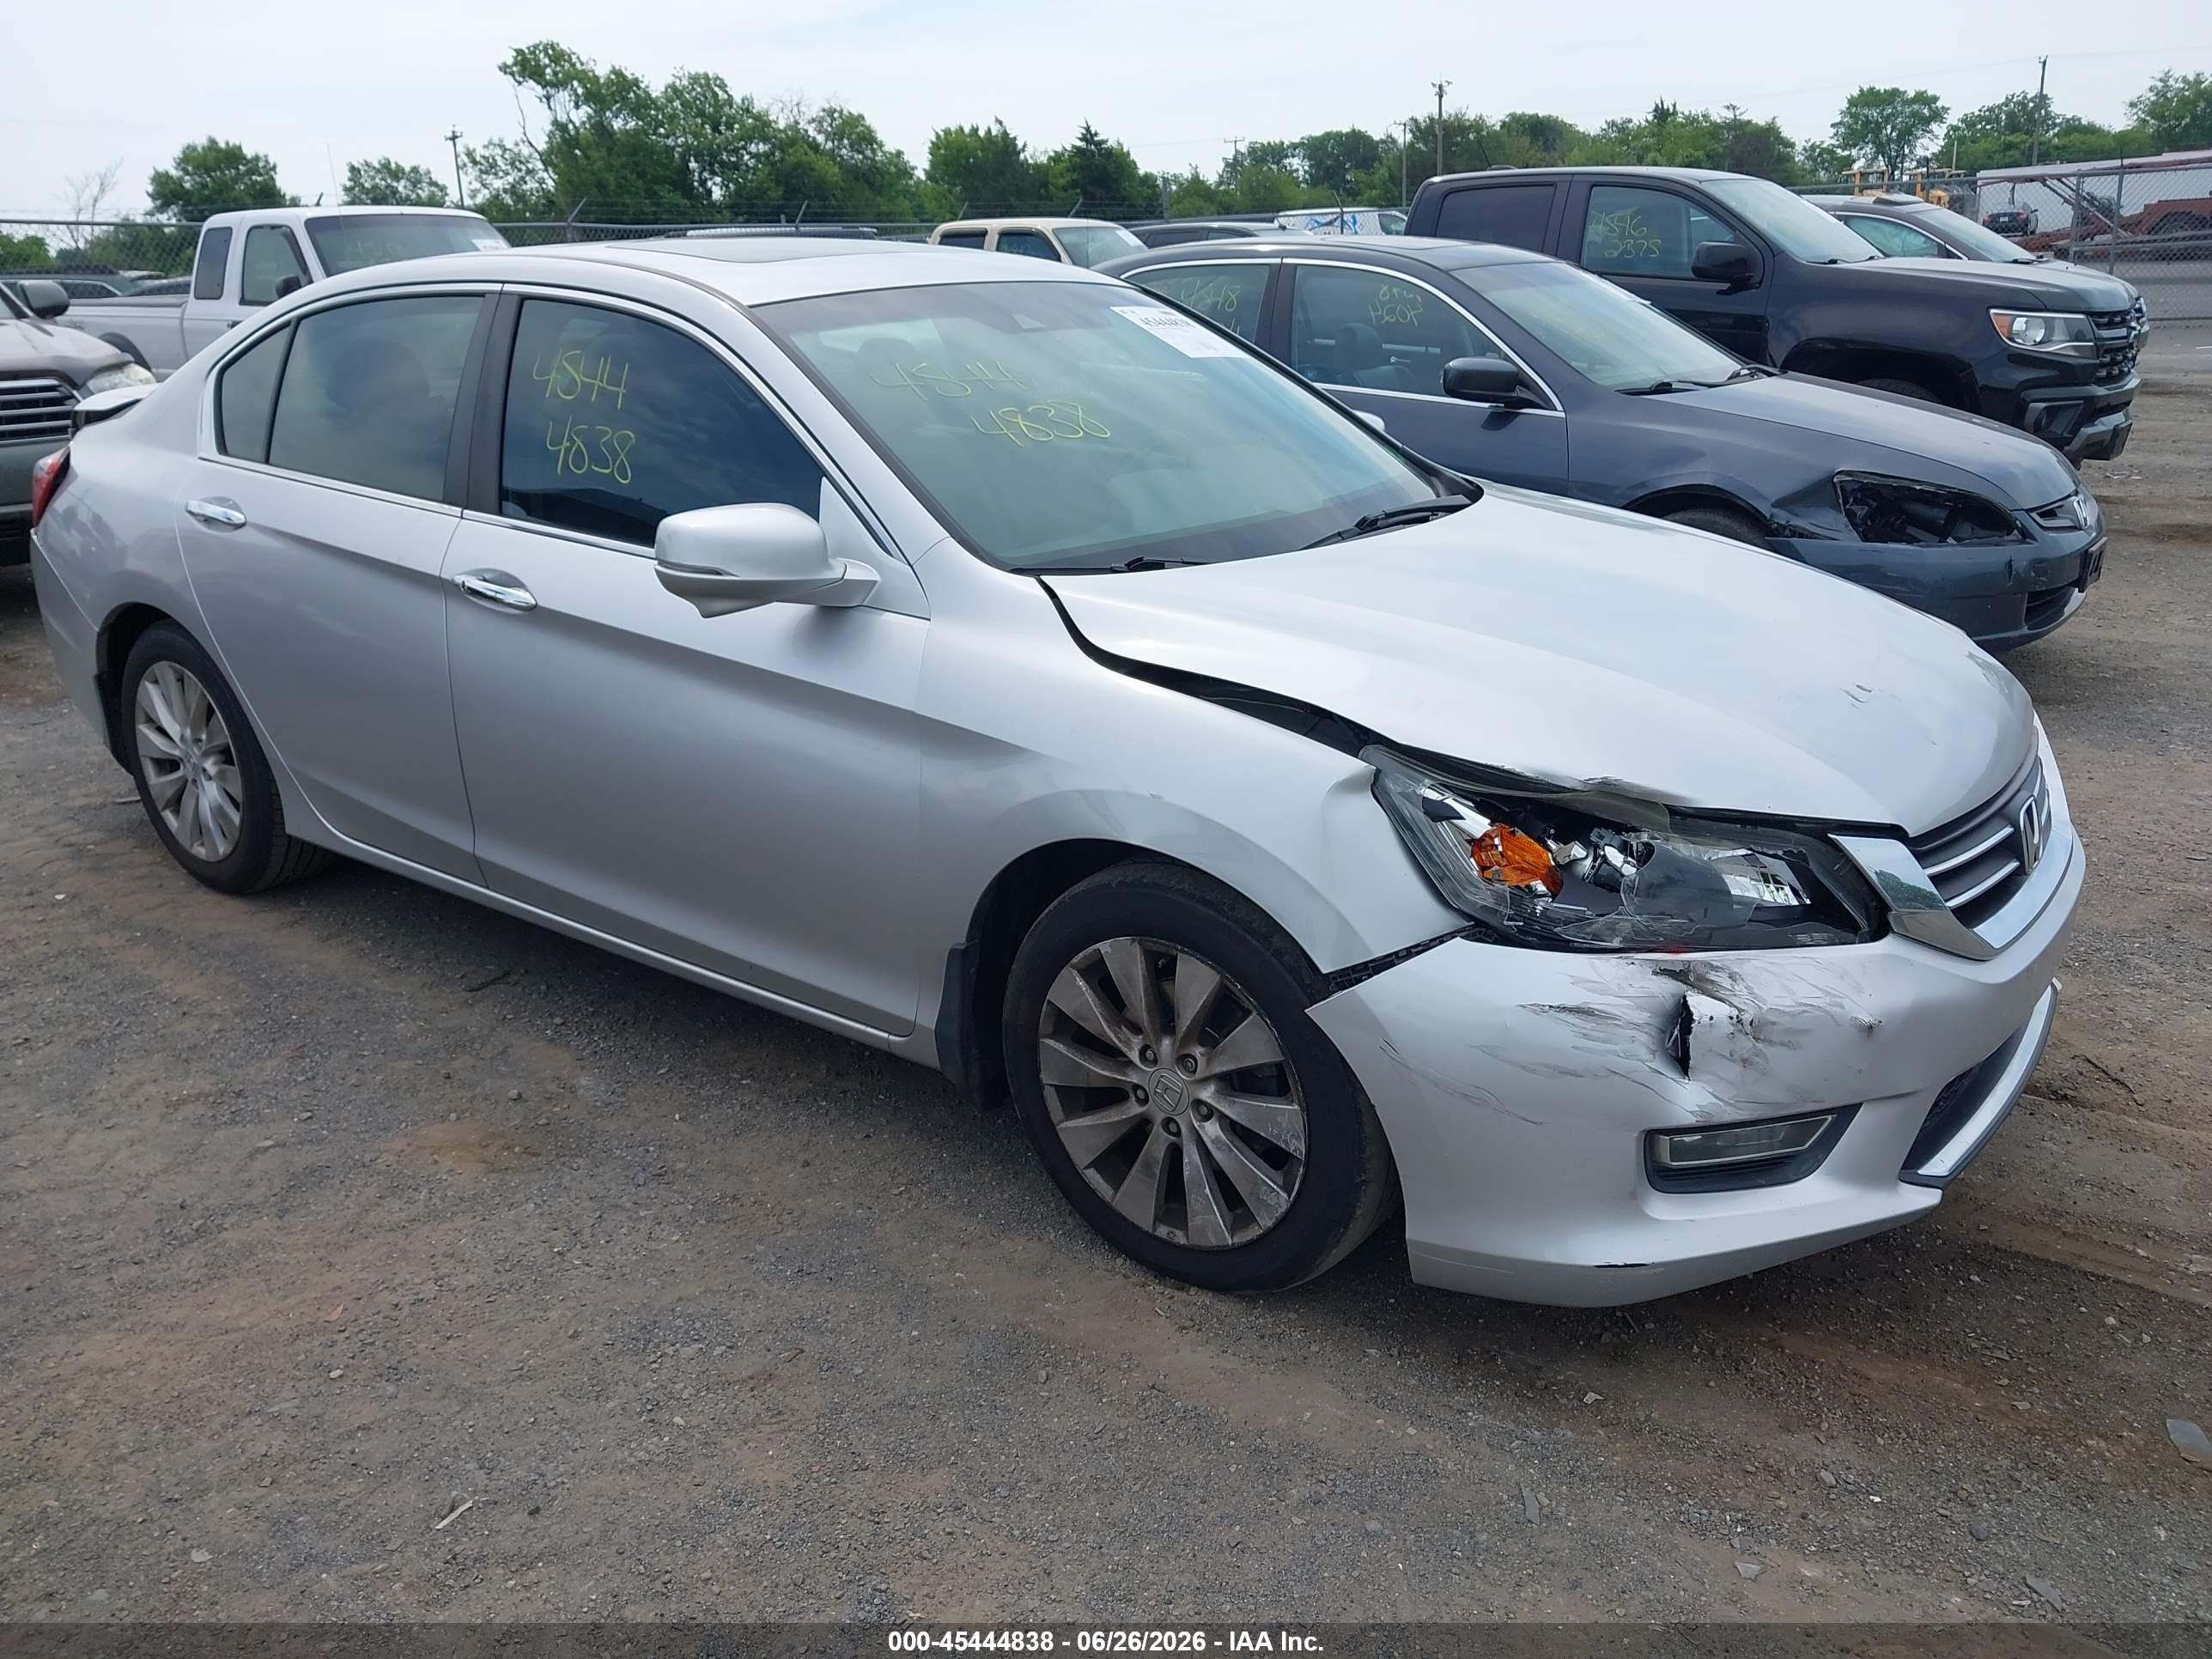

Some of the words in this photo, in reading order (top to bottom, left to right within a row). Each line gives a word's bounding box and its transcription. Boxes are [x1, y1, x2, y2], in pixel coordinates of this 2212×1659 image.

[1603, 239, 1662, 258] 2375
[532, 348, 629, 410] 4544
[868, 360, 1027, 401] 4544
[969, 399, 1111, 447] 4838
[544, 416, 636, 484] 4838
